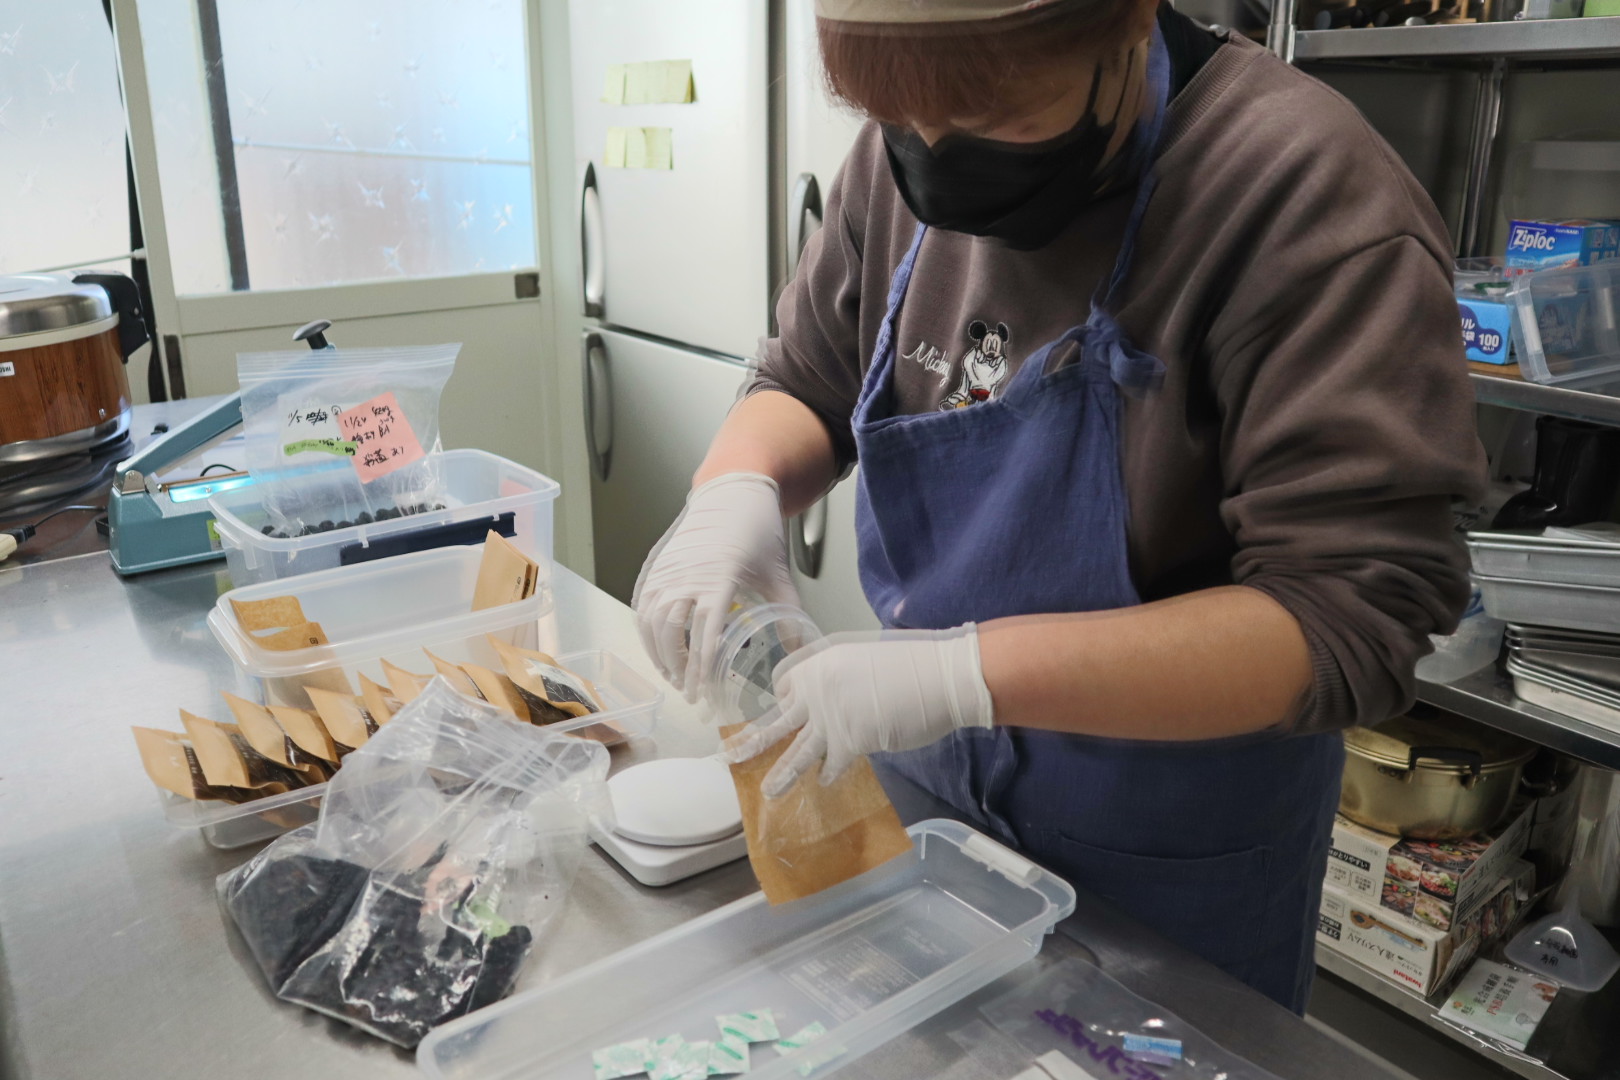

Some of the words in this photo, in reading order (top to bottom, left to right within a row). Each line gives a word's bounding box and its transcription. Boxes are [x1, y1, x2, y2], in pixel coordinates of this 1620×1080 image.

[1513, 228, 1556, 252] Ziploc
[1478, 333, 1500, 348] 100
[1394, 969, 1423, 988] Iwatani
